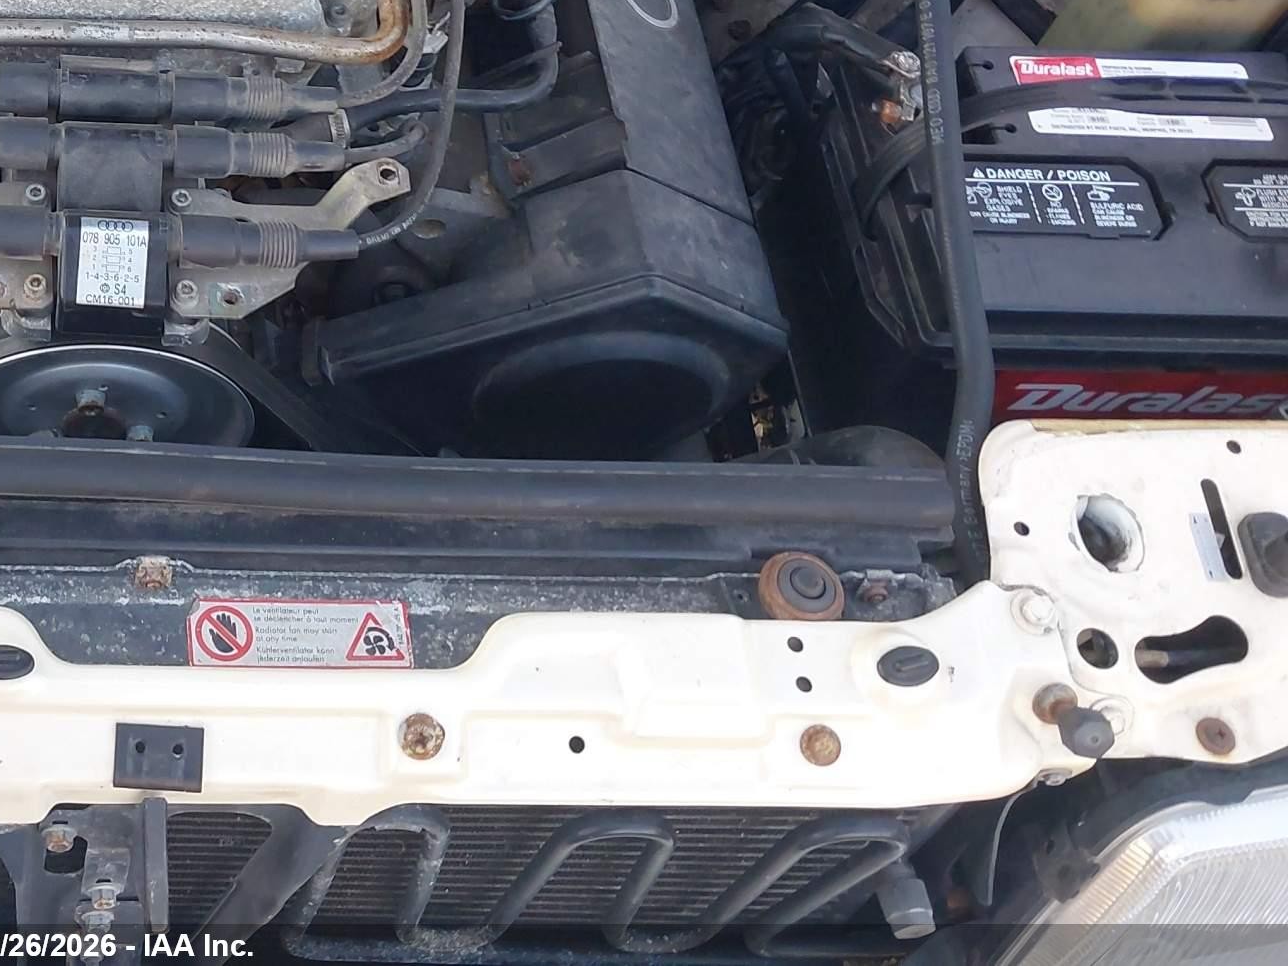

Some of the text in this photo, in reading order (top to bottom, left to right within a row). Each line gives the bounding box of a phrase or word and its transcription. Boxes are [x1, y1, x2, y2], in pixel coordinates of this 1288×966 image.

[1017, 60, 1095, 76] Duralast
[985, 167, 1043, 180] DANGER
[1057, 170, 1111, 182] POISON
[83, 231, 147, 248] 078 905 101A
[114, 283, 127, 295] S4
[85, 294, 135, 306] CM16-001
[303, 608, 319, 617] peut
[255, 625, 286, 634] Radiator
[289, 625, 300, 634] fan
[304, 628, 318, 636] may
[265, 636, 279, 644] any
[317, 646, 334, 654] kann
[257, 655, 325, 663] jederzeit anlaufen
